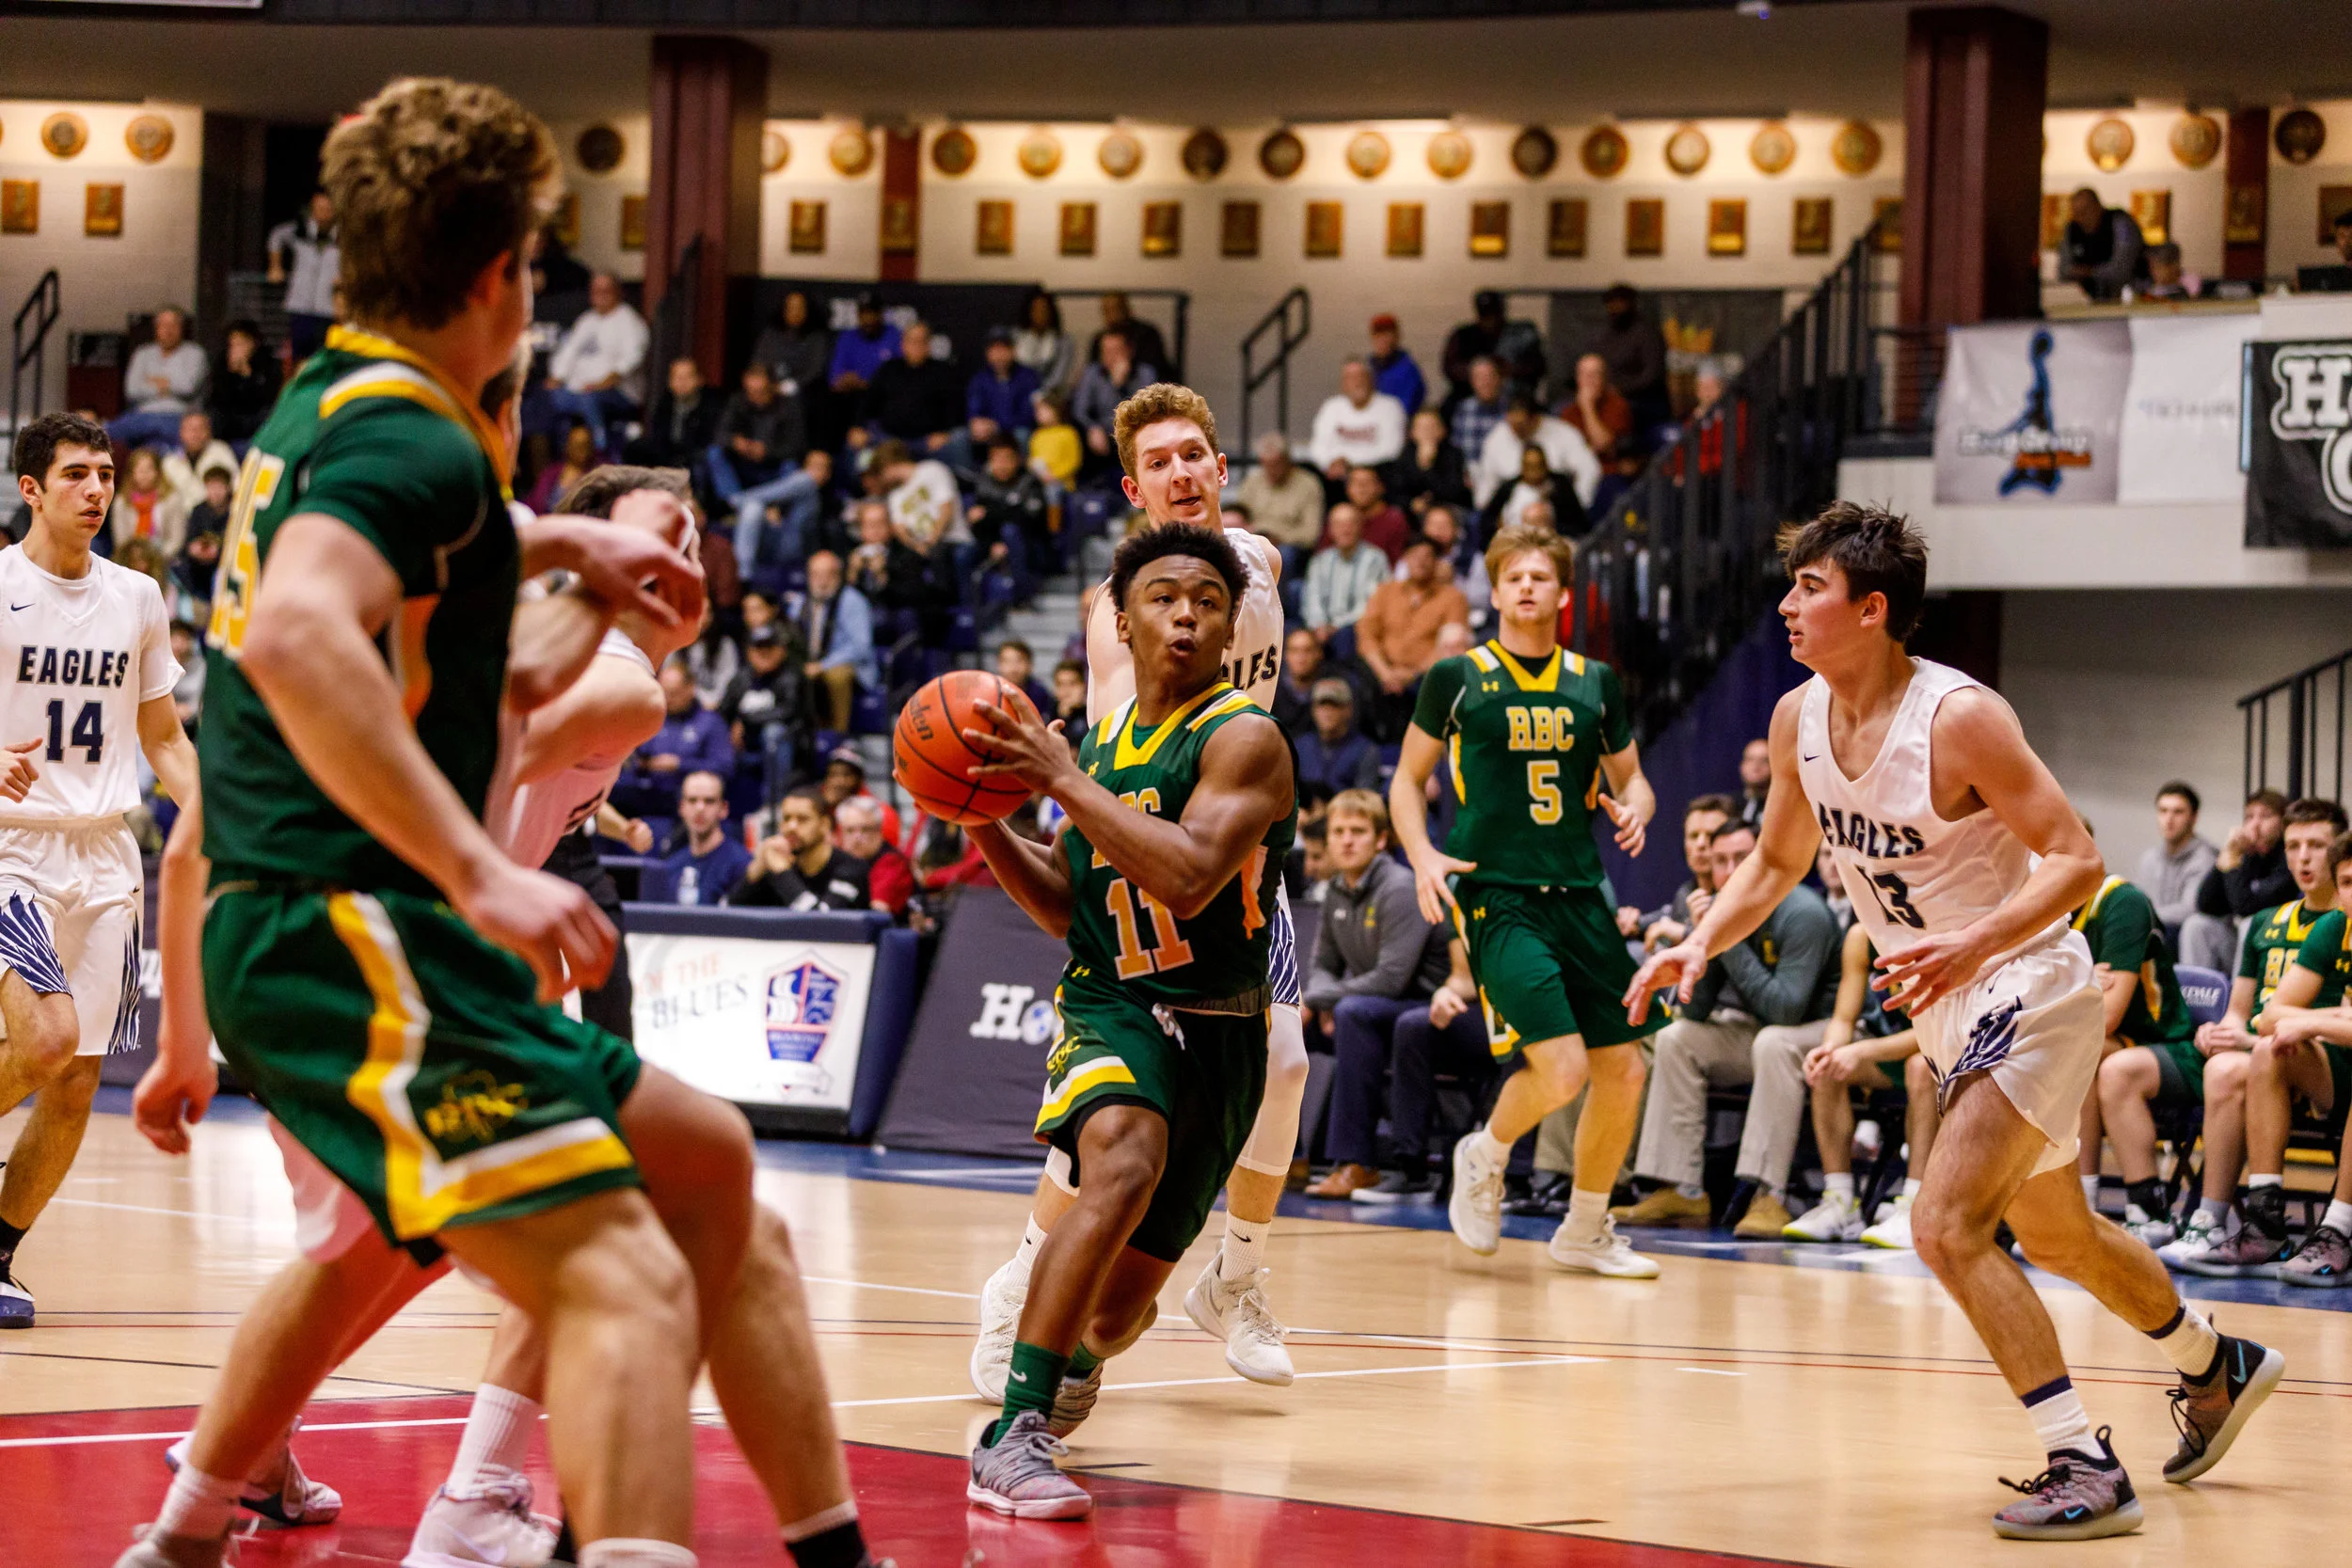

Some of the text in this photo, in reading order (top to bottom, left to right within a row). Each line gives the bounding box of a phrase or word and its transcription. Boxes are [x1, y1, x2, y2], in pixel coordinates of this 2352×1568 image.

[16, 644, 130, 689] EAGLES
[45, 697, 104, 765] 14
[1505, 705, 1575, 751] RBC
[1526, 759, 1564, 825] 5
[1818, 800, 1927, 860] EAGLES
[1105, 877, 1195, 981] 11
[651, 972, 750, 1030] BLUES
